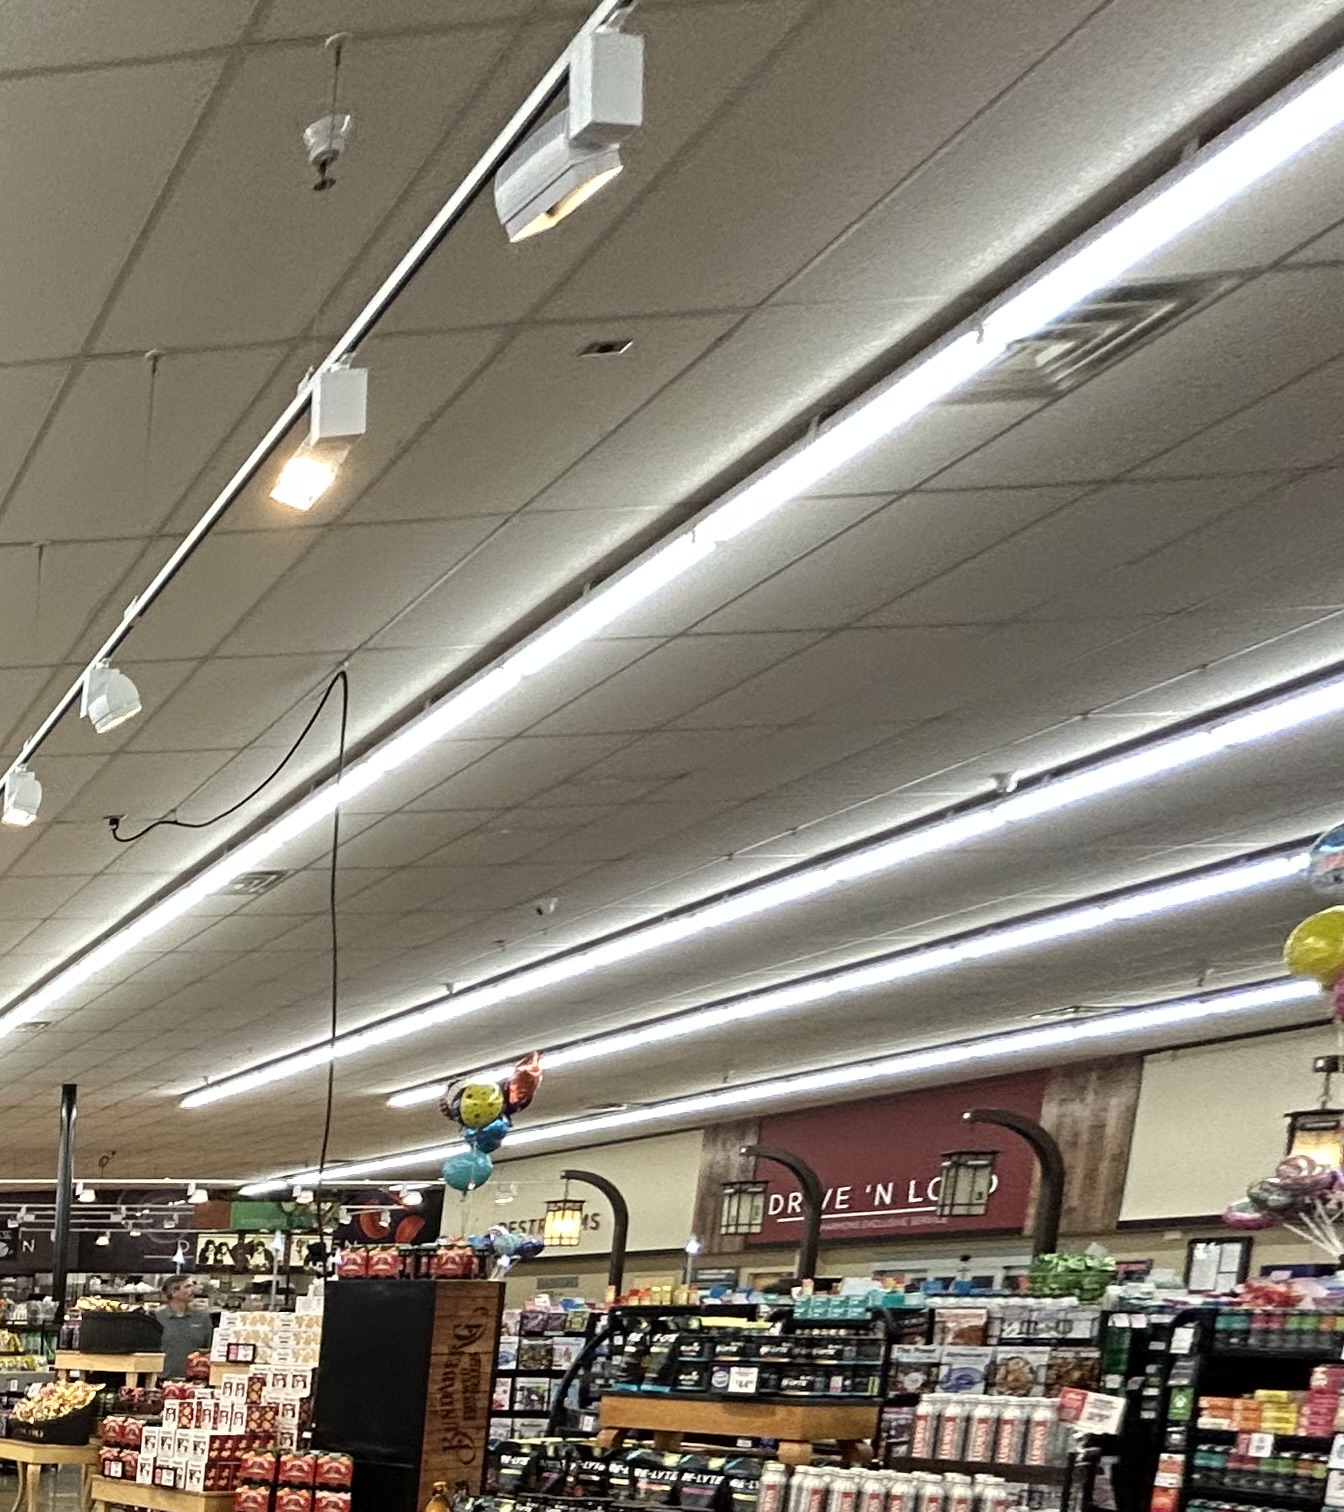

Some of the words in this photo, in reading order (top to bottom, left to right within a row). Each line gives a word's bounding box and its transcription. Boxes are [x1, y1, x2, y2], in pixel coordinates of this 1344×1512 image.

[768, 1186, 852, 1216] DRVE
[909, 1173, 999, 1204] LO
[498, 1212, 600, 1235] ESTRS
